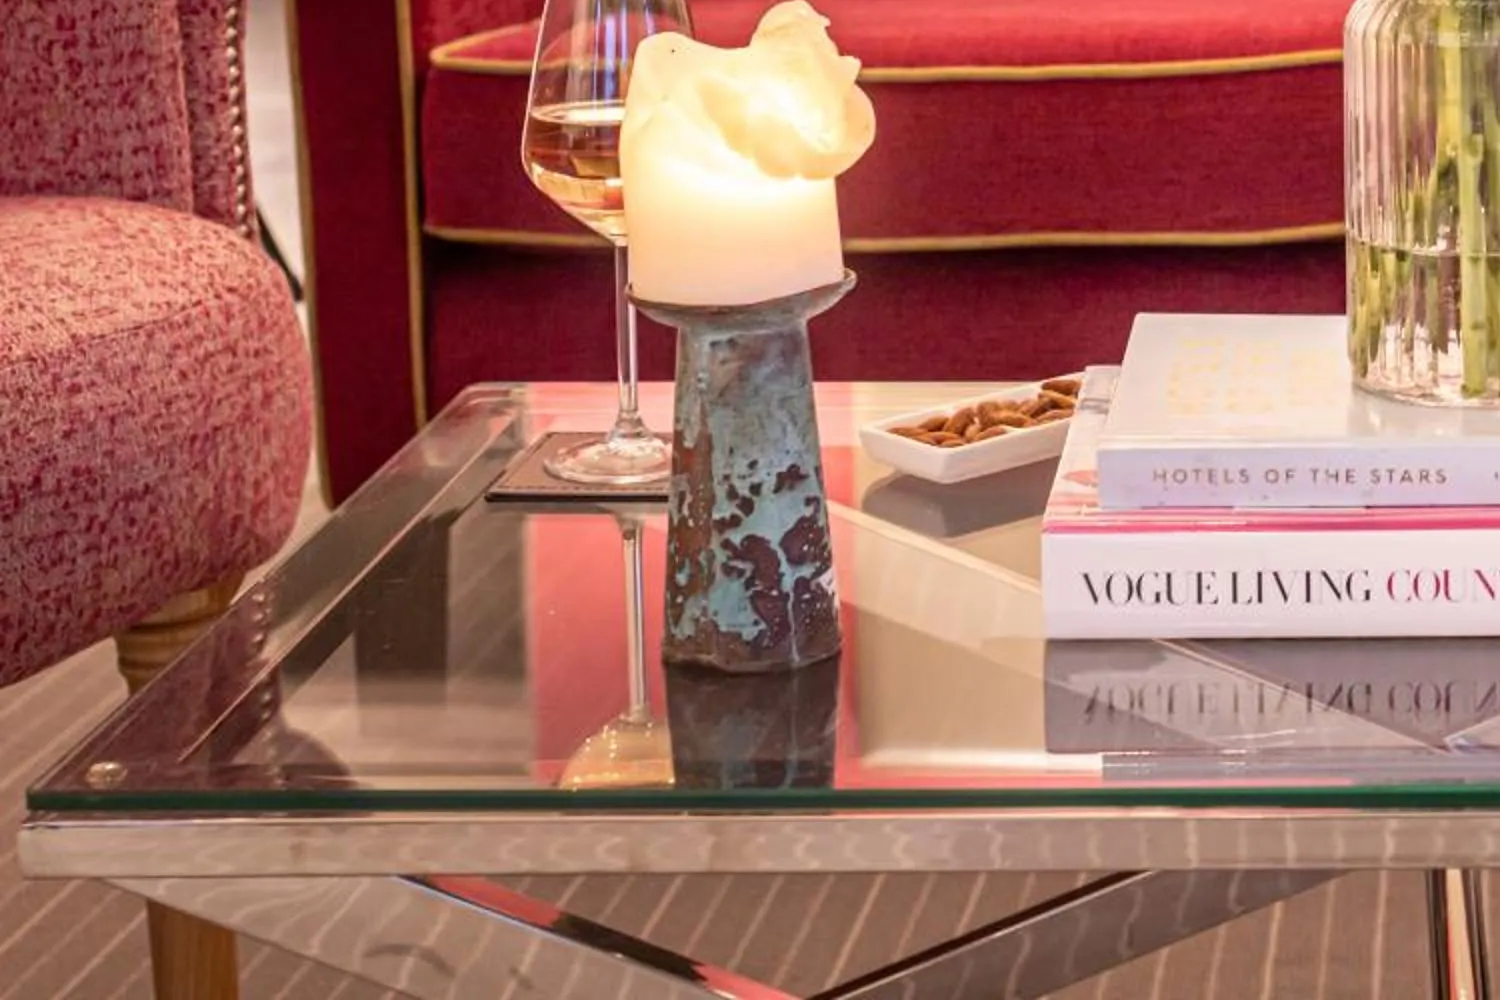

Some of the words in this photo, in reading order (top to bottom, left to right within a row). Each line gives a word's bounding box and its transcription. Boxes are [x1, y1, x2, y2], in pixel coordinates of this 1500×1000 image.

[1152, 467, 1250, 485] HOTELS
[1263, 467, 1296, 484] OF
[1309, 467, 1357, 484] THE
[1369, 467, 1448, 484] STARS
[1081, 571, 1219, 606] VOGUE
[1229, 569, 1372, 605] LIVING
